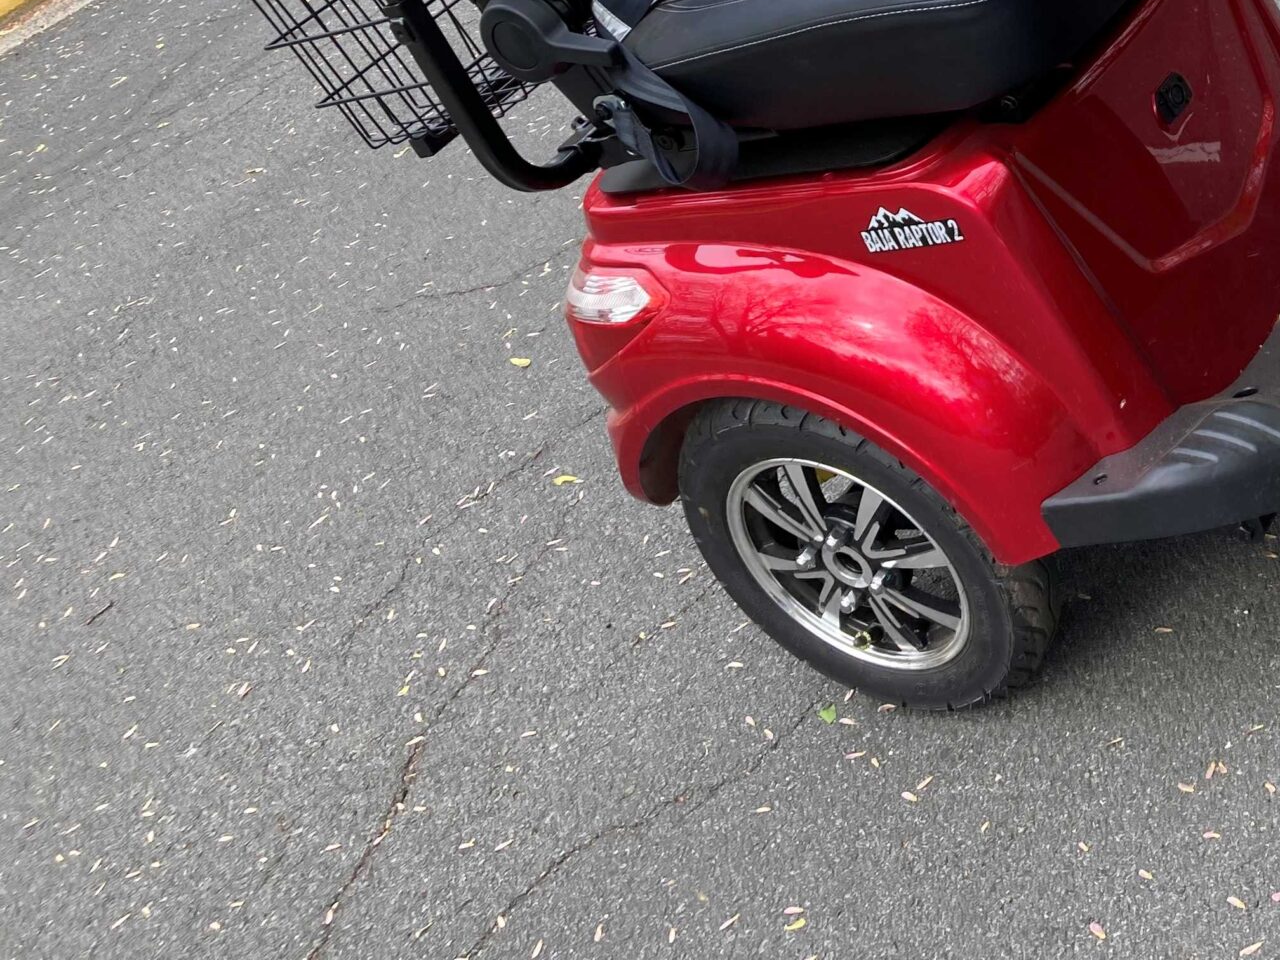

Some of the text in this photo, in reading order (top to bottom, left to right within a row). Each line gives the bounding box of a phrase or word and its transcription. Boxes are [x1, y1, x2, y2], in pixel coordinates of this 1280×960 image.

[860, 219, 964, 253] BAJA RAPTOR 2
